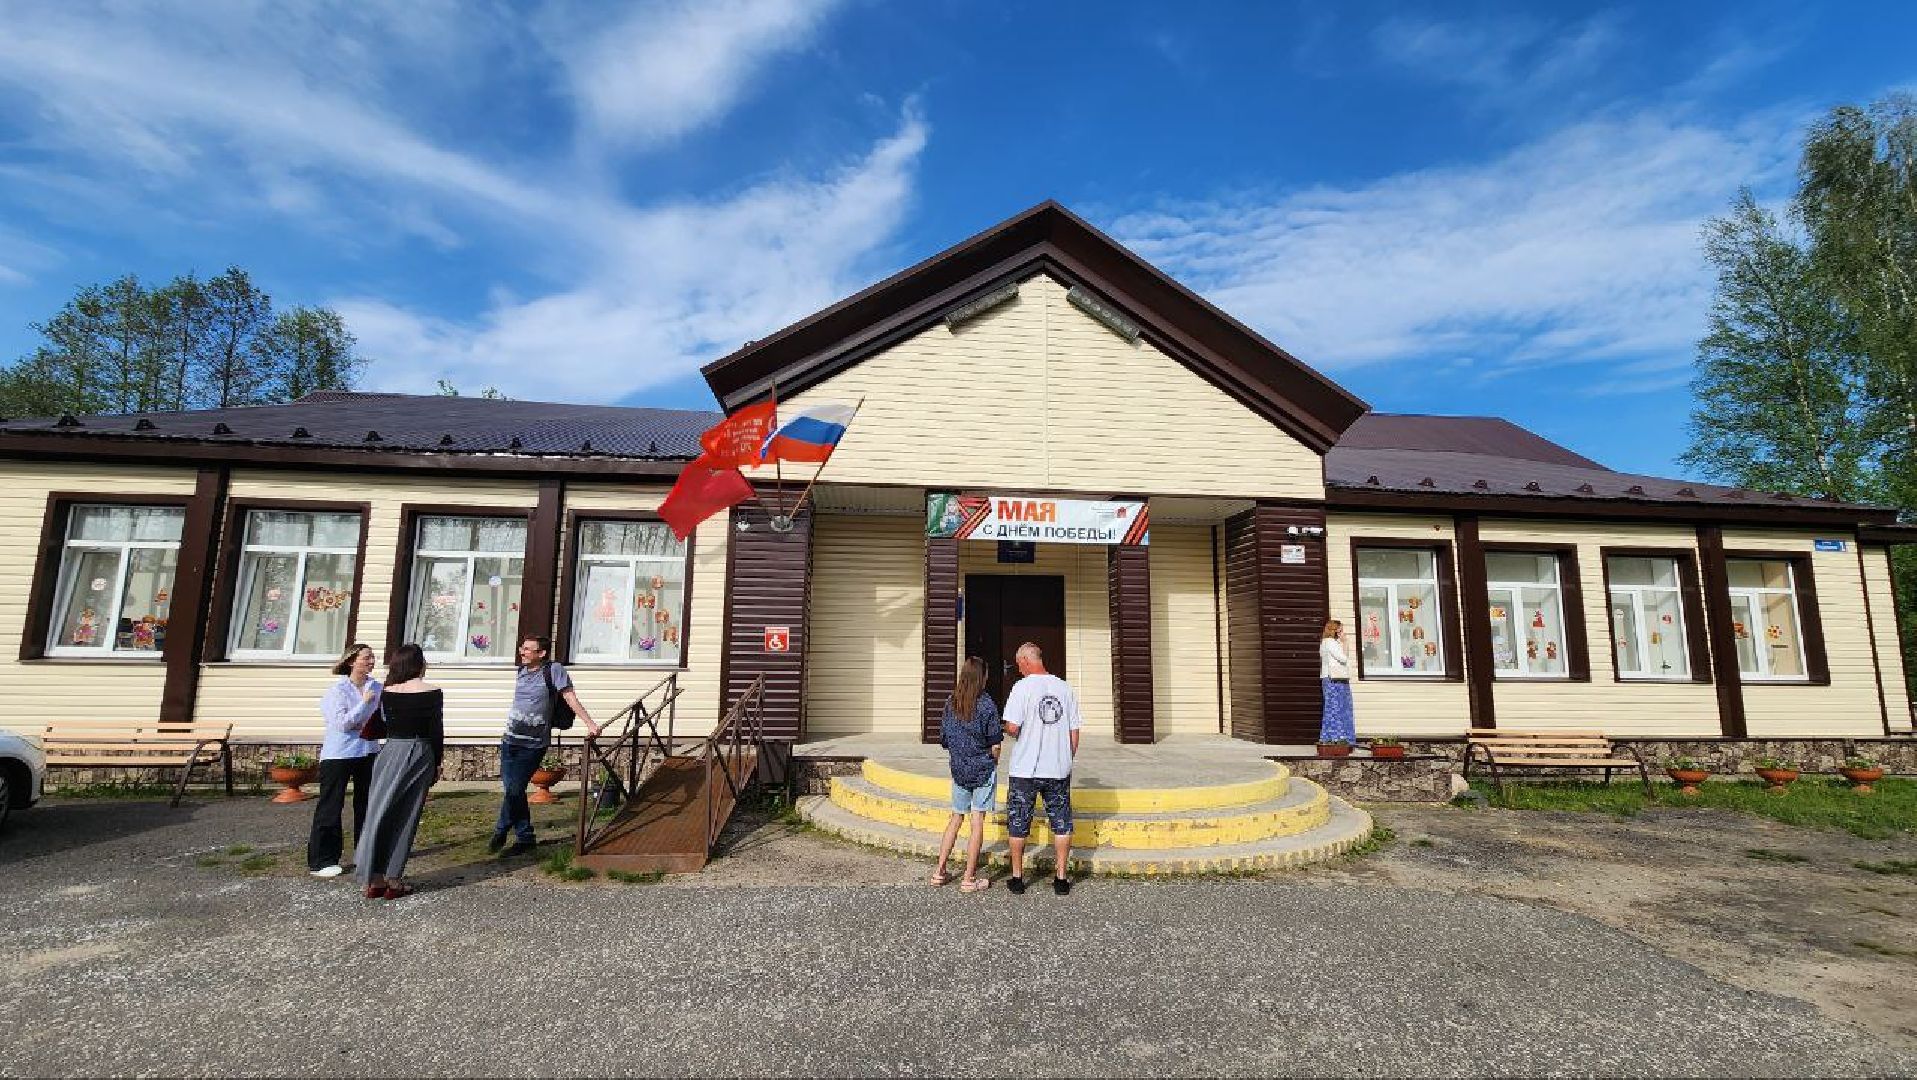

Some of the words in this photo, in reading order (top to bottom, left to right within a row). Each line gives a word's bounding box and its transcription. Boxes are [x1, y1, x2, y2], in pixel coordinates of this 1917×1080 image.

[997, 500, 1056, 522] МАЯ
[983, 524, 993, 535] С
[996, 523, 1040, 538] ДНЁМ
[1044, 526, 1116, 542] ПОБЕДЫ!
